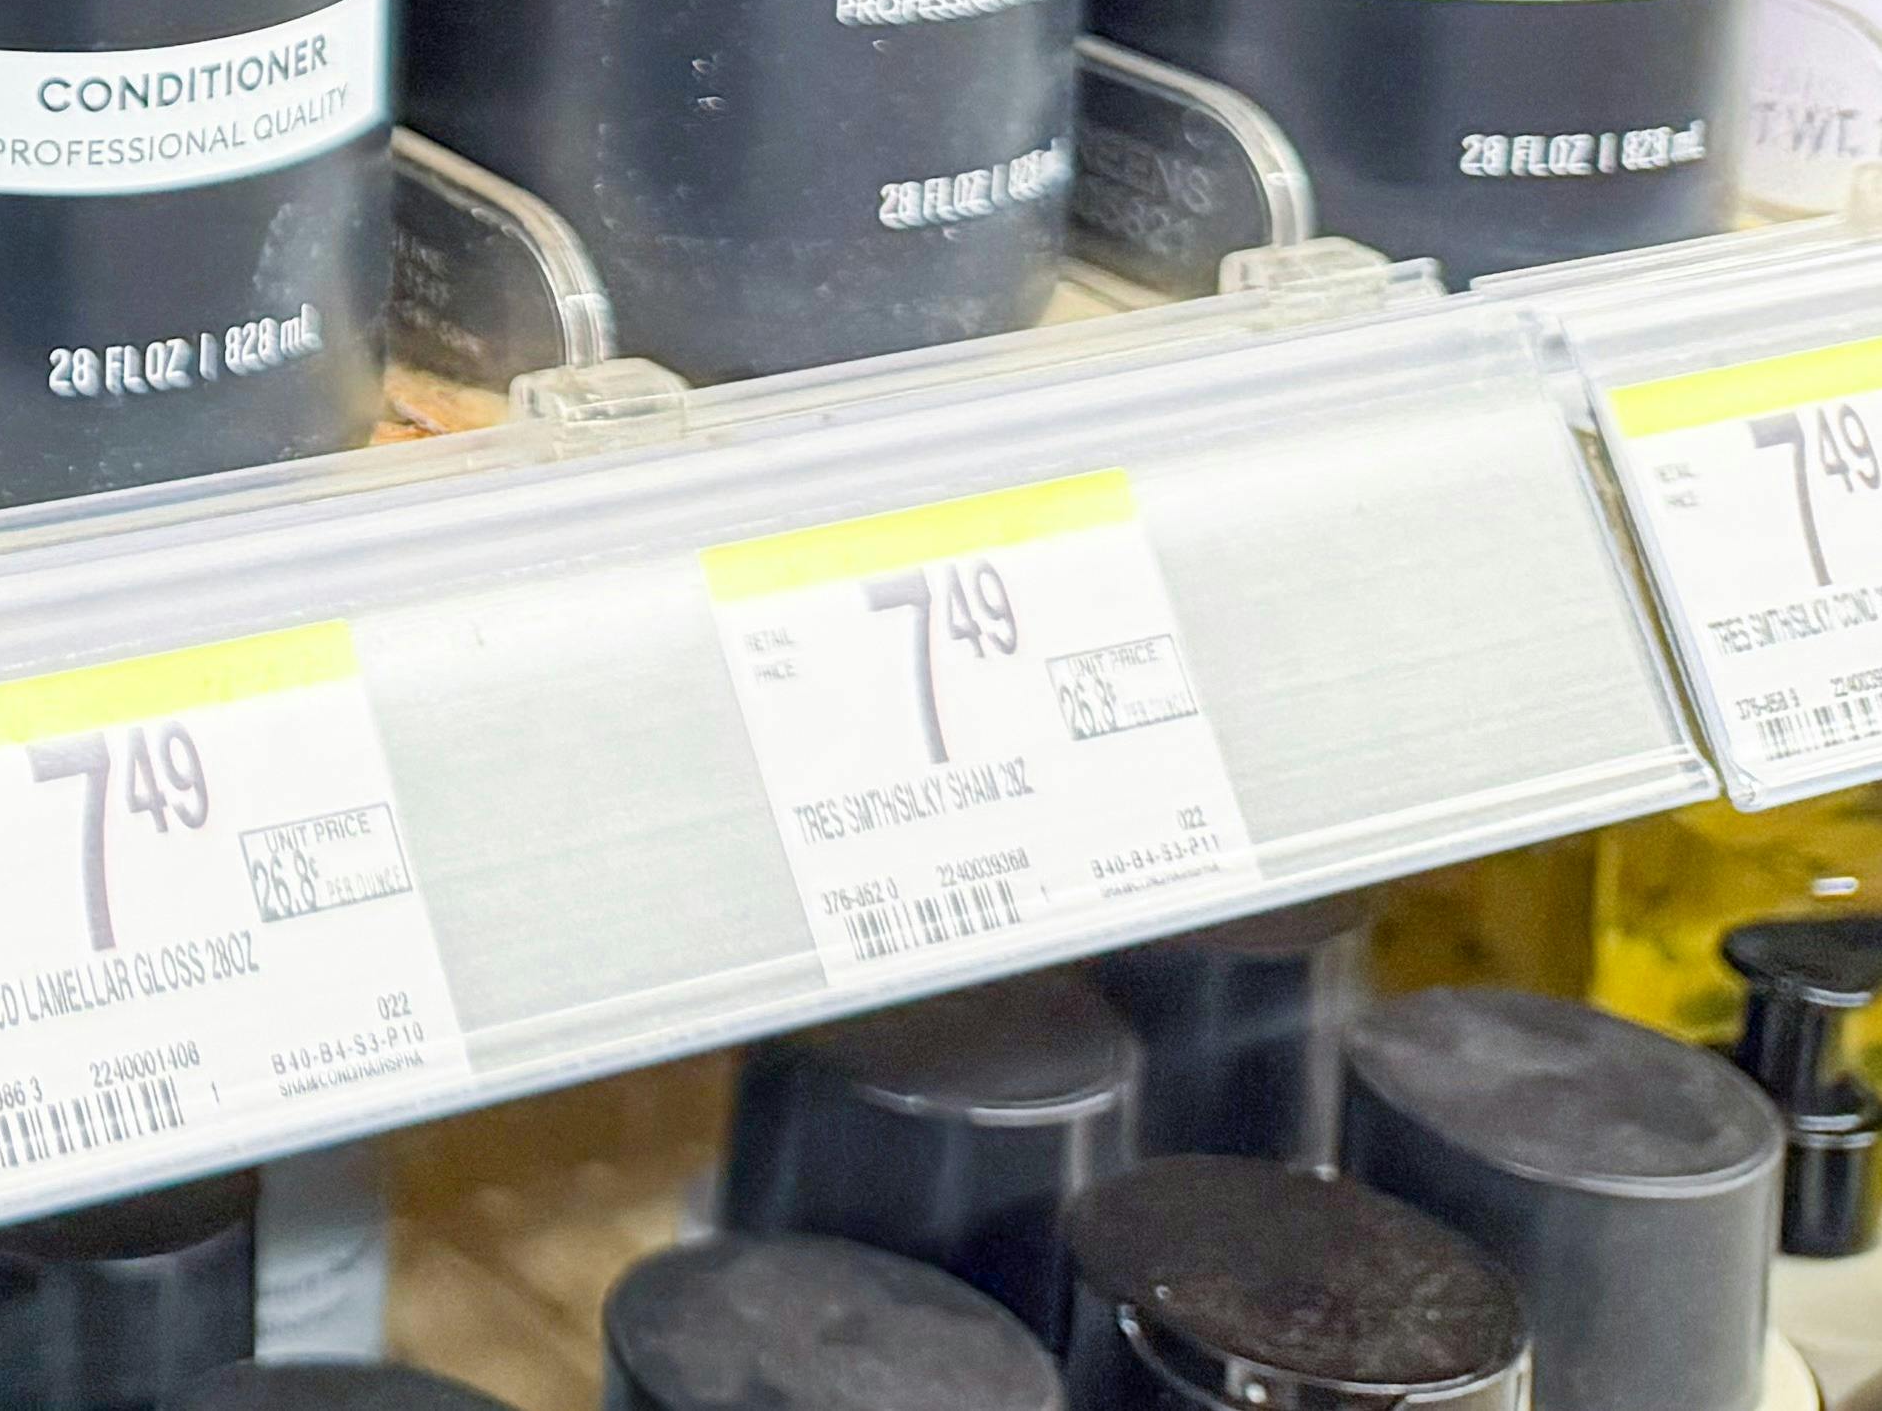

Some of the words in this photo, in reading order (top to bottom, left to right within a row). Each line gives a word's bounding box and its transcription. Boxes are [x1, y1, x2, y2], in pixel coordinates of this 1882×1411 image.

[38, 34, 328, 113] CONDITIONER
[253, 82, 350, 140] QUALITY
[48, 348, 101, 396] 28
[225, 317, 277, 376] 828
[263, 827, 309, 853] UNIT
[312, 812, 371, 840] PRICE
[19, 958, 134, 1021] LAMELLAR
[135, 946, 206, 995] GLOSS
[378, 992, 412, 1019] 022
